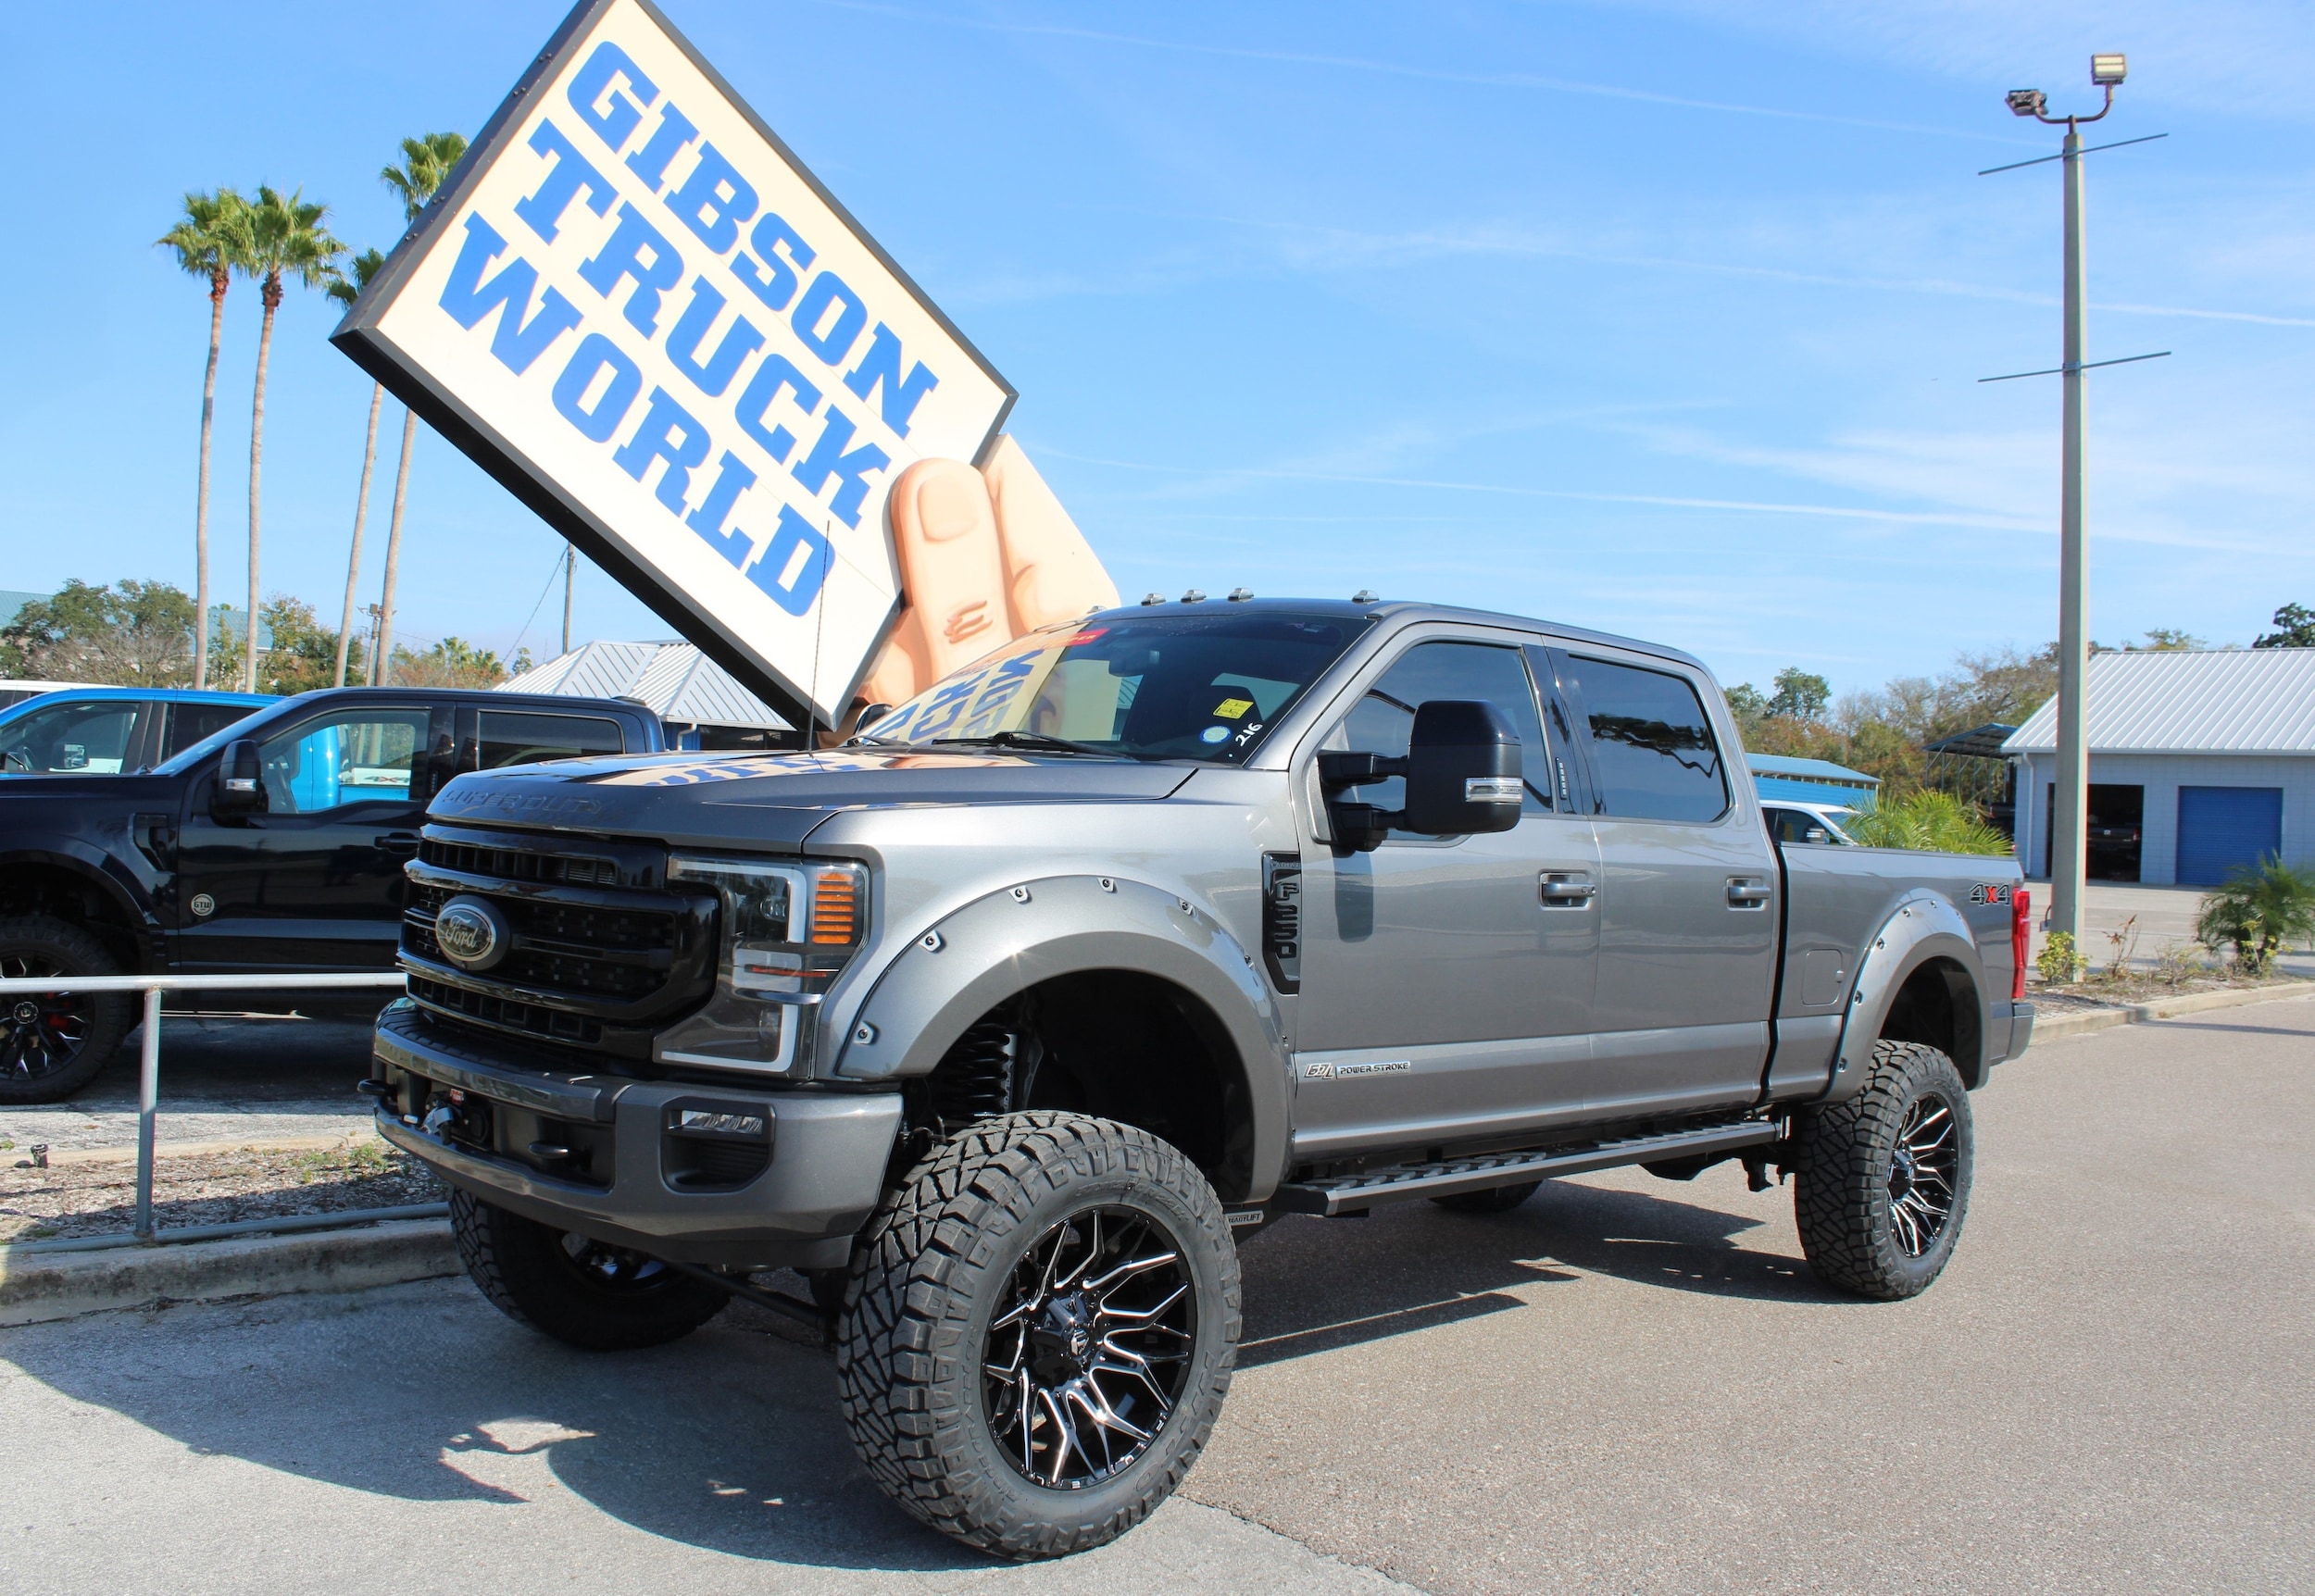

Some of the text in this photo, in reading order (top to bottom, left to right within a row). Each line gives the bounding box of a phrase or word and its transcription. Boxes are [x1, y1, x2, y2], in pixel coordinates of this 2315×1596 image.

[567, 41, 939, 440] GIBSON
[513, 118, 892, 531] TRUCK
[438, 210, 835, 617] WORLD
[1235, 722, 1263, 747] 216
[442, 789, 616, 815] SUPER DUTY
[445, 915, 478, 948] Ford
[1340, 1066, 1371, 1074] POWER
[1373, 1062, 1408, 1072] STROKE
